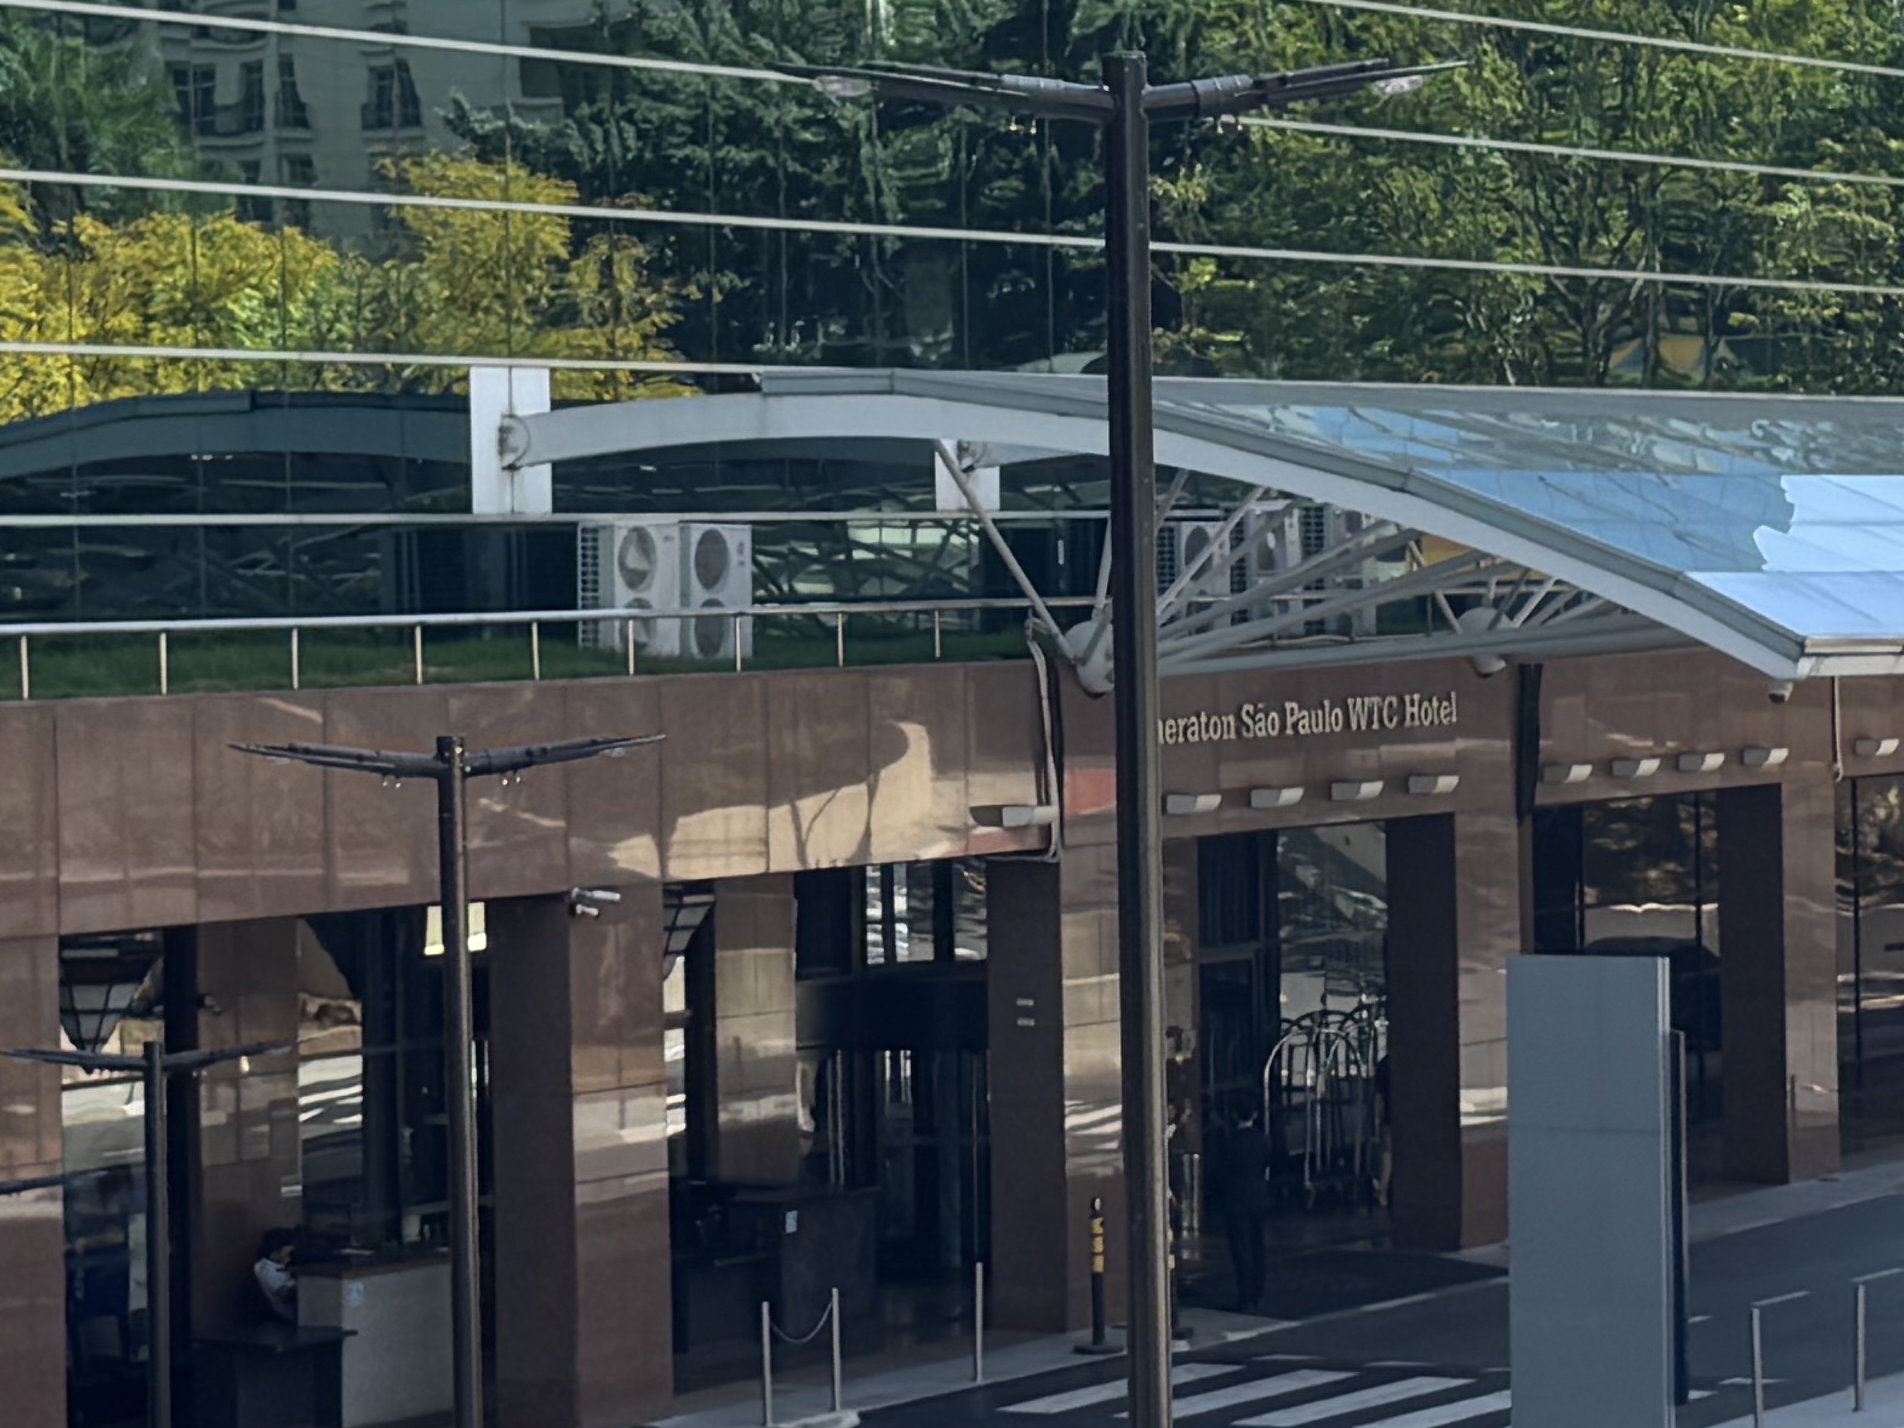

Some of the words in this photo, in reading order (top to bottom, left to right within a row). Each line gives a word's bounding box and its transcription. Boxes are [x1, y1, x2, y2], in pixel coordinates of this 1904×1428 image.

[1157, 711, 1236, 745] eraton
[1242, 703, 1280, 738] São
[1284, 699, 1344, 735] Paulo
[1347, 695, 1398, 731] WTC
[1404, 691, 1457, 727] Hotel
